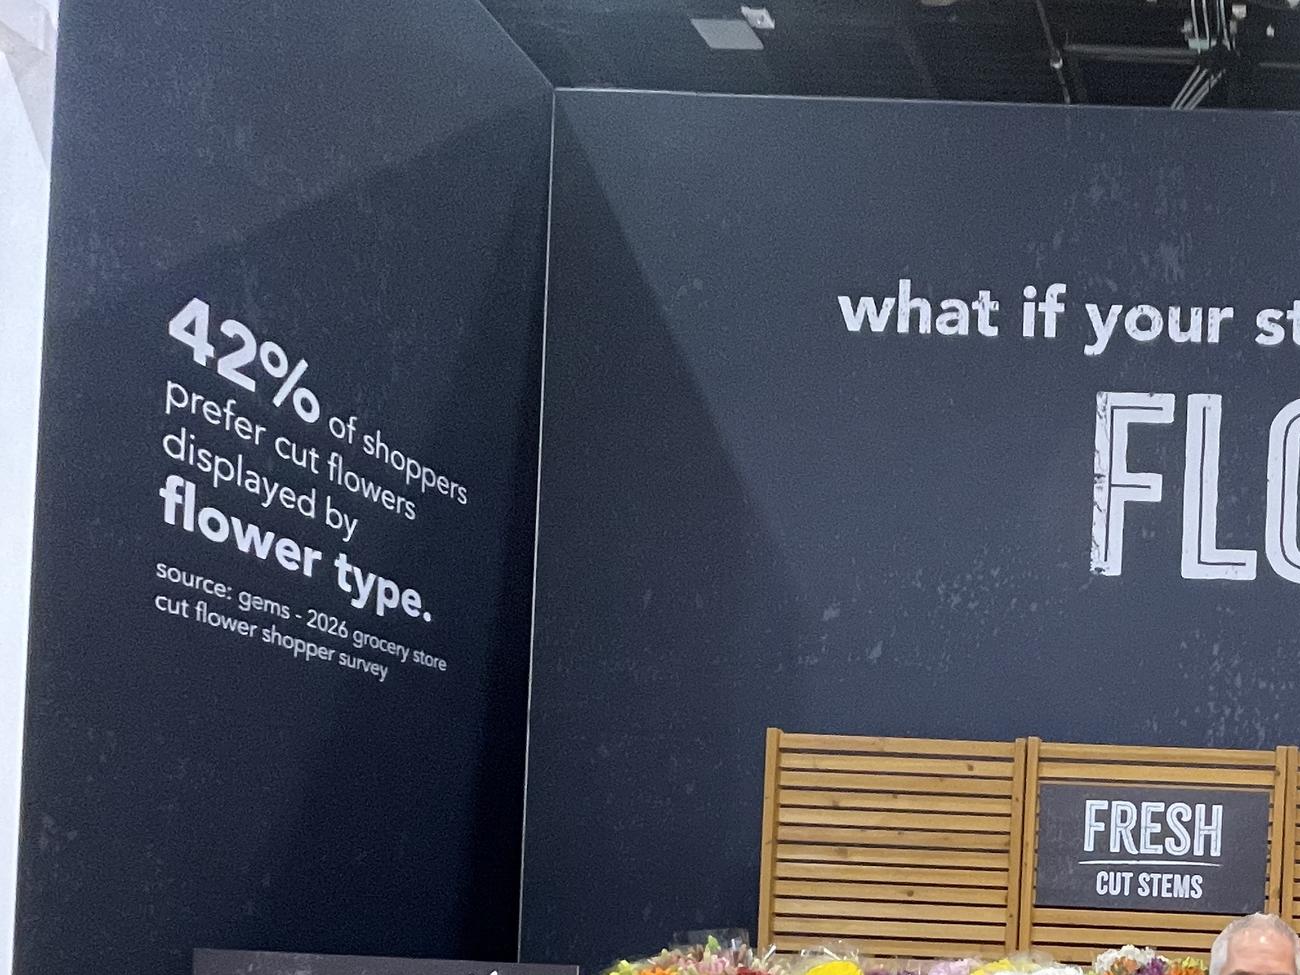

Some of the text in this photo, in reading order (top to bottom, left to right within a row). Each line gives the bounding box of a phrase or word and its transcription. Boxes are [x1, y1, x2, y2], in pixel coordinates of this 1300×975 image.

[838, 279, 999, 337] what
[1022, 284, 1067, 338] if
[1083, 301, 1234, 356] your
[165, 379, 417, 520] prefer cut flowers
[168, 297, 469, 505] 42% of shoppers
[162, 427, 358, 542] displayed by
[159, 476, 432, 622] flower type.
[155, 593, 388, 682] cut flower shopper survey
[156, 561, 232, 600] source:
[239, 588, 290, 620] gems
[306, 609, 348, 639] 2026
[353, 630, 409, 662] grocery
[413, 648, 447, 671] store
[1083, 799, 1224, 857] FRESH
[1096, 871, 1203, 899] CUT STEMS
